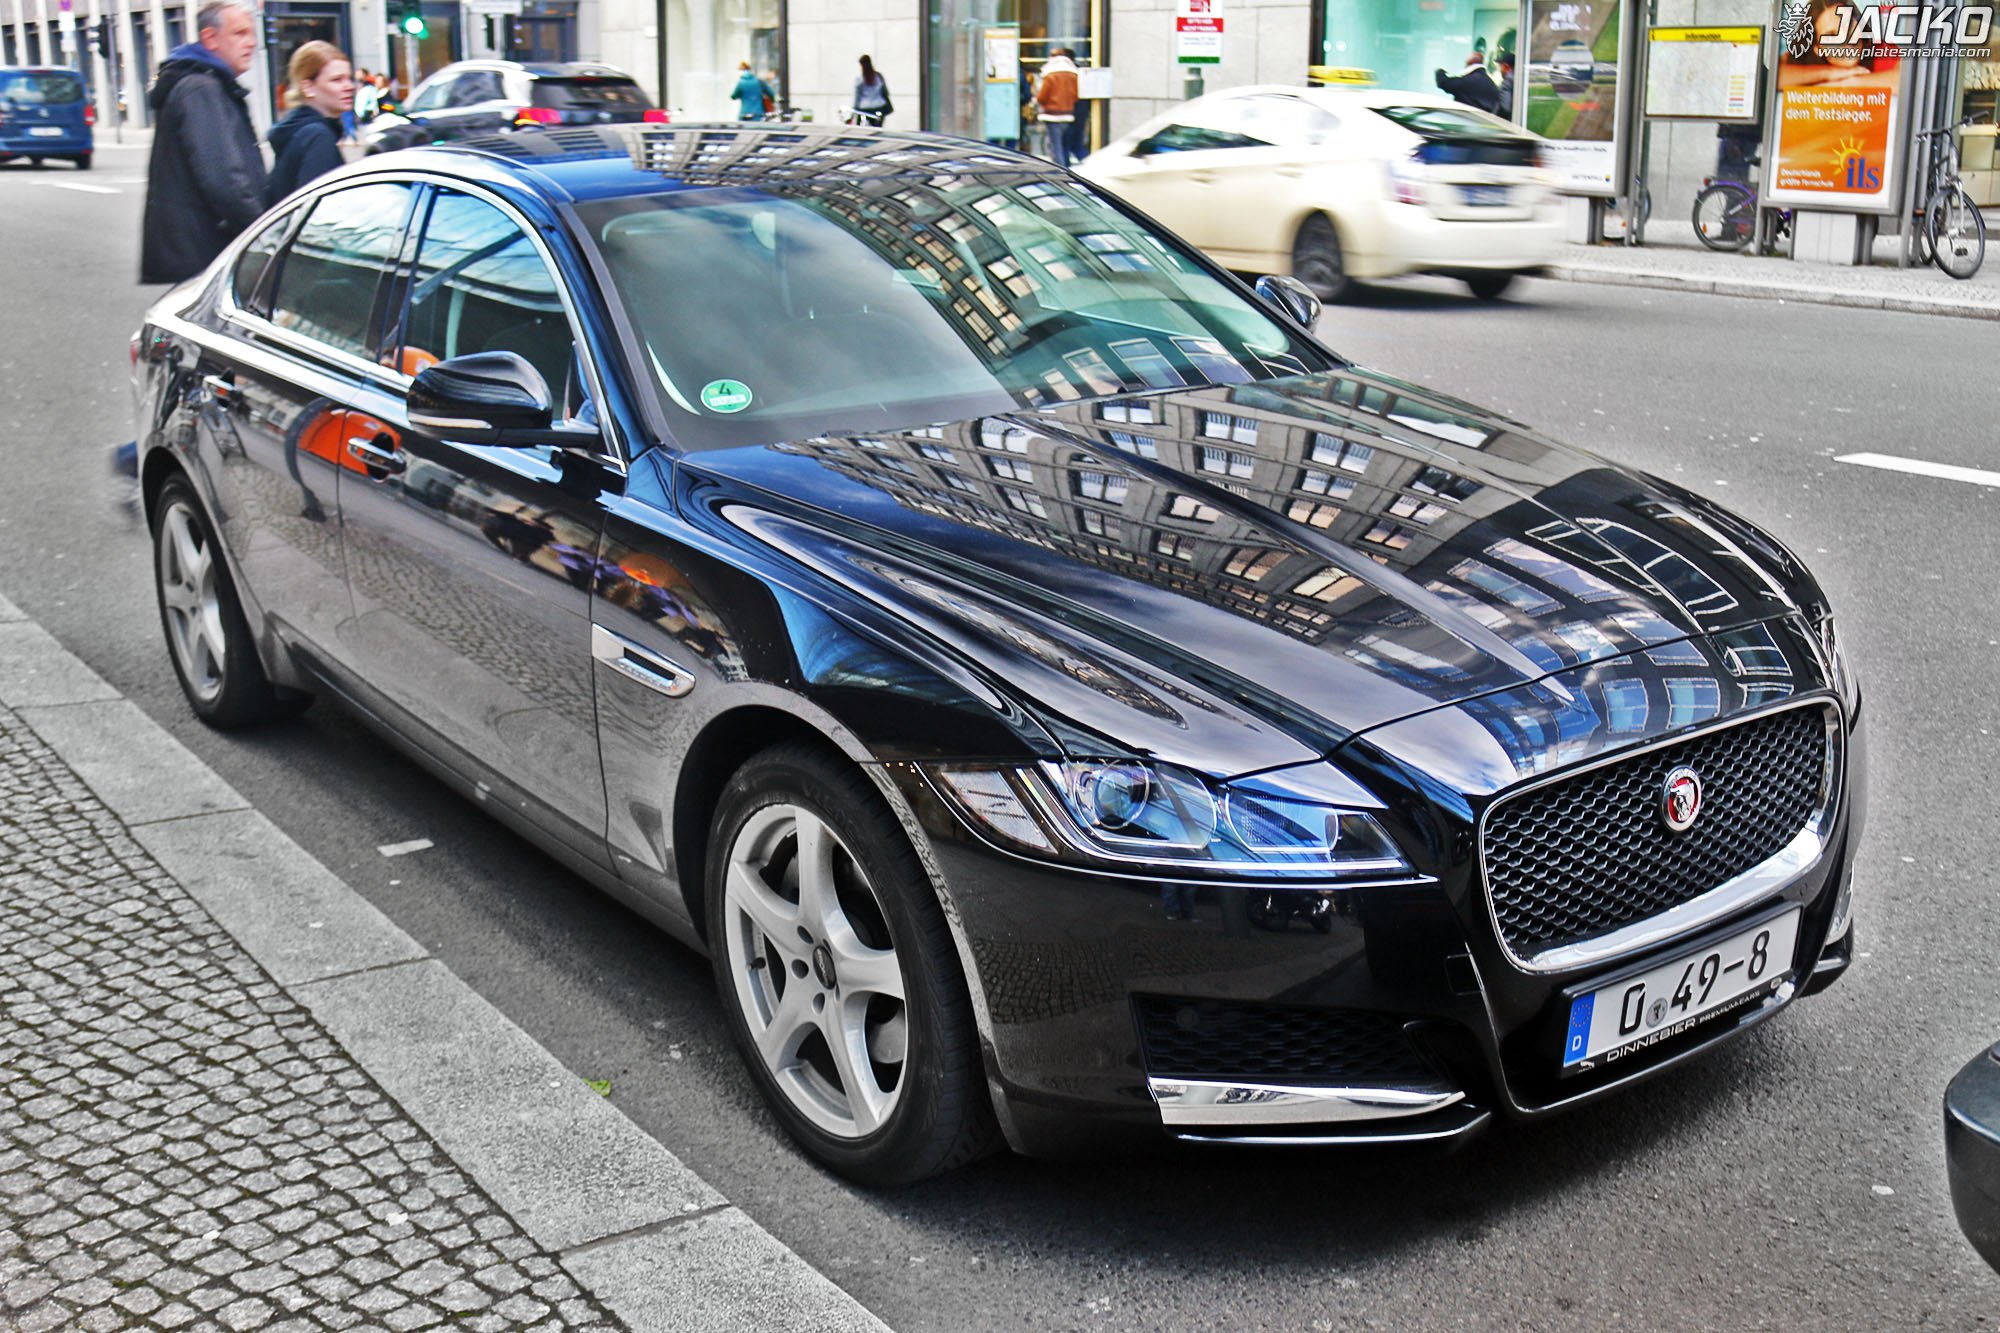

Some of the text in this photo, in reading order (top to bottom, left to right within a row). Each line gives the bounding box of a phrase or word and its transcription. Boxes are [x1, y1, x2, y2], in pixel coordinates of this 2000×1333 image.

[1786, 91, 1887, 107] Weiterbildung mit
[1785, 107, 1873, 124] dem Testsieger.
[1846, 157, 1880, 189] ils
[719, 383, 732, 395] 4
[1571, 1035, 1582, 1052] D
[1606, 1016, 1697, 1063] DINNEBIER
